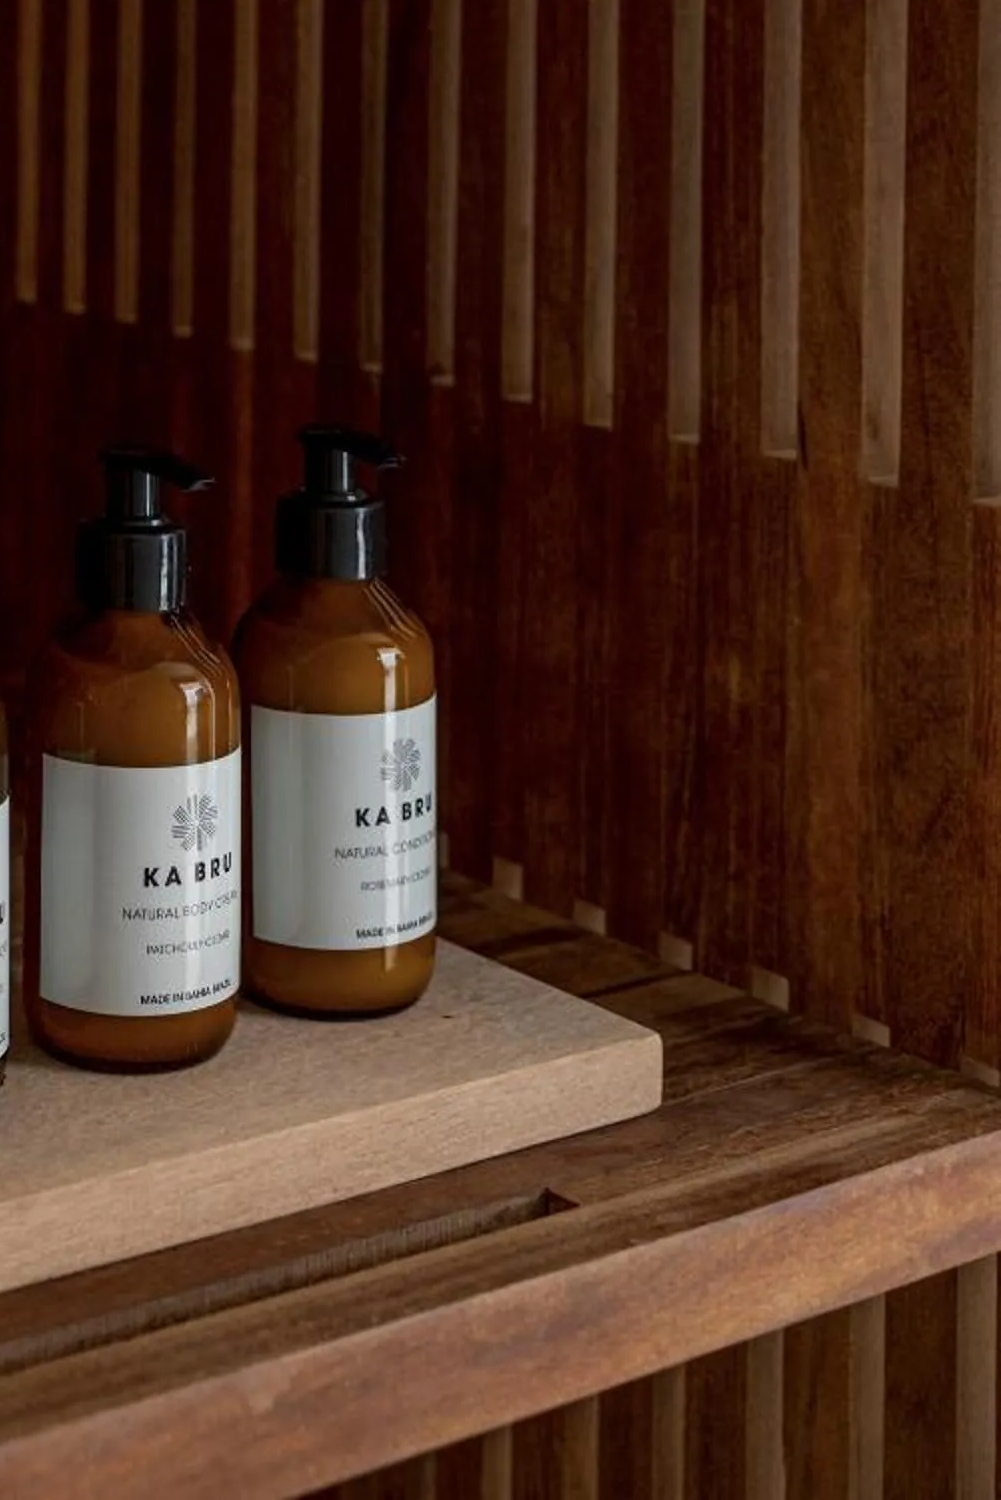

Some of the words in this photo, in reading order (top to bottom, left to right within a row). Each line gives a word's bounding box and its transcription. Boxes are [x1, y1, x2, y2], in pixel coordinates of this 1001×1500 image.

[355, 805, 391, 828] KA
[334, 846, 389, 860] NATURAL
[143, 865, 182, 888] KA
[194, 851, 232, 883] BRU
[121, 906, 179, 922] NATURAL
[355, 925, 384, 940] MADE
[140, 993, 171, 1005] MADE
[172, 992, 184, 1002] IN
